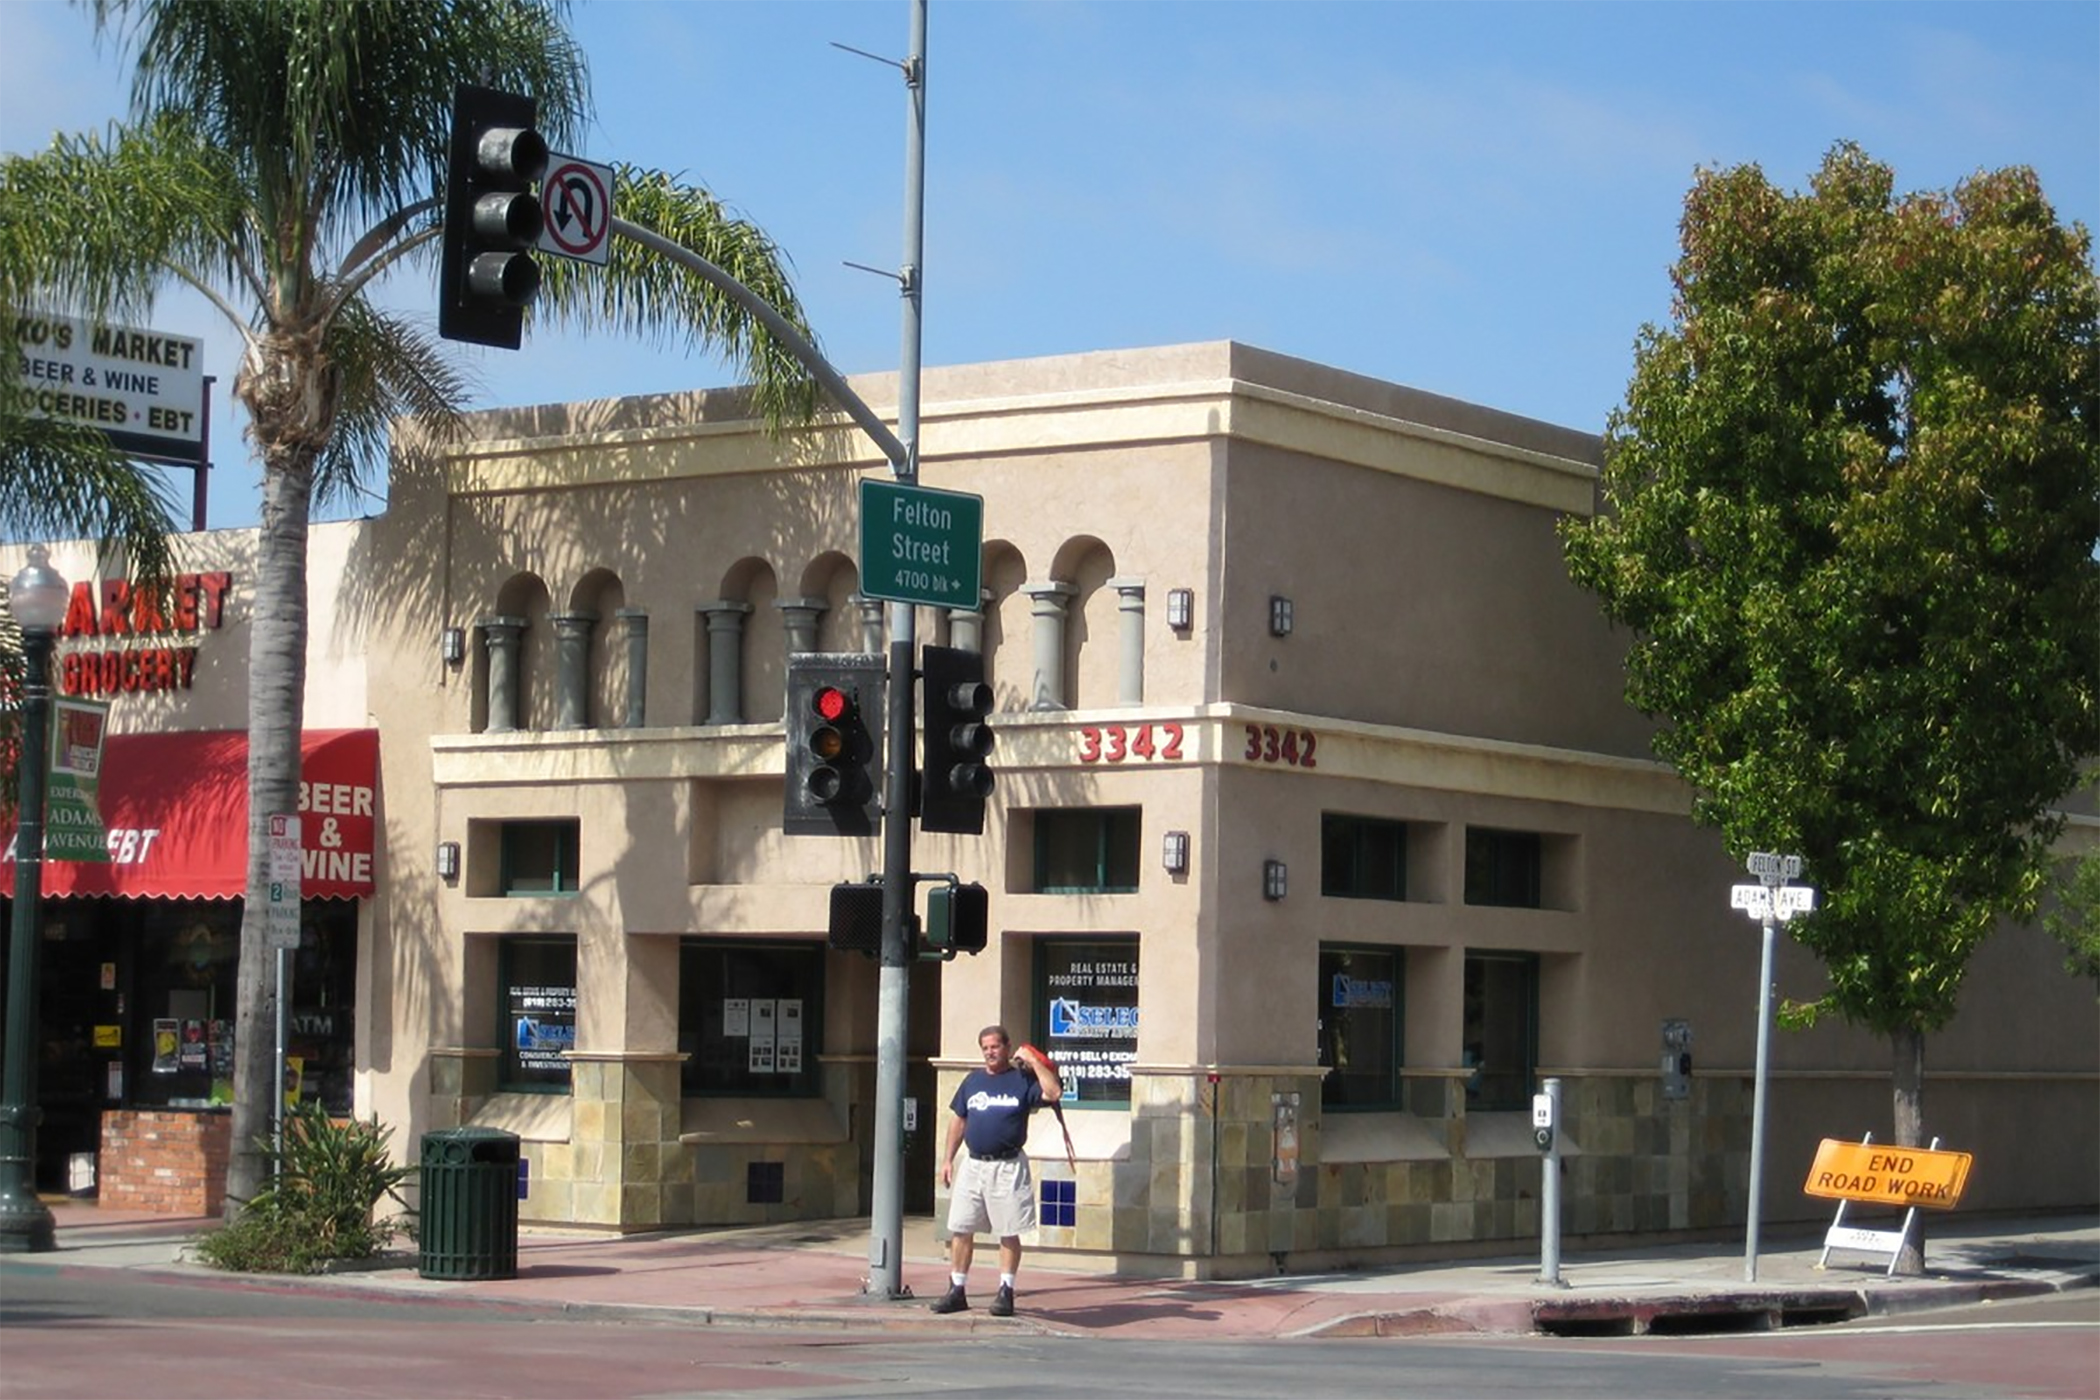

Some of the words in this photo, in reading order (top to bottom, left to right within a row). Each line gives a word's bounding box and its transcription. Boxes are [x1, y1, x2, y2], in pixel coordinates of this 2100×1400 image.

[17, 318, 73, 350] KO'S
[93, 327, 194, 369] MARKET
[21, 357, 74, 383] BEER
[82, 366, 96, 386] &
[105, 370, 160, 396] WINE
[21, 388, 127, 424] OCERIES
[148, 406, 193, 433] EBT
[893, 496, 952, 530] Felton
[892, 532, 950, 565] Street
[895, 569, 929, 590] 4700
[932, 575, 948, 592] blk
[60, 572, 231, 637] ARKET
[63, 648, 197, 697] GROCERY
[1079, 722, 1184, 763] 3342
[1244, 723, 1317, 768] 3342
[298, 782, 374, 817] BEER
[51, 833, 106, 849] AVENUE
[272, 818, 285, 835] NO
[319, 817, 343, 848] &
[107, 829, 160, 863] EBT
[272, 885, 282, 900] 2
[1735, 888, 1774, 908] ADAMS
[1049, 975, 1093, 987] PROPERTY
[1070, 963, 1093, 974] REAL
[1095, 963, 1127, 974] ESTATE
[1079, 1006, 1138, 1027] SELEC
[1054, 1051, 1072, 1061] BUY
[1080, 1051, 1101, 1061] SELL
[1109, 1051, 1138, 1061] EXCHA
[1087, 1064, 1130, 1079] 283-35
[1868, 1154, 1914, 1174] END
[1817, 1171, 1877, 1193] ROAD
[1887, 1177, 1950, 1200] WORK
